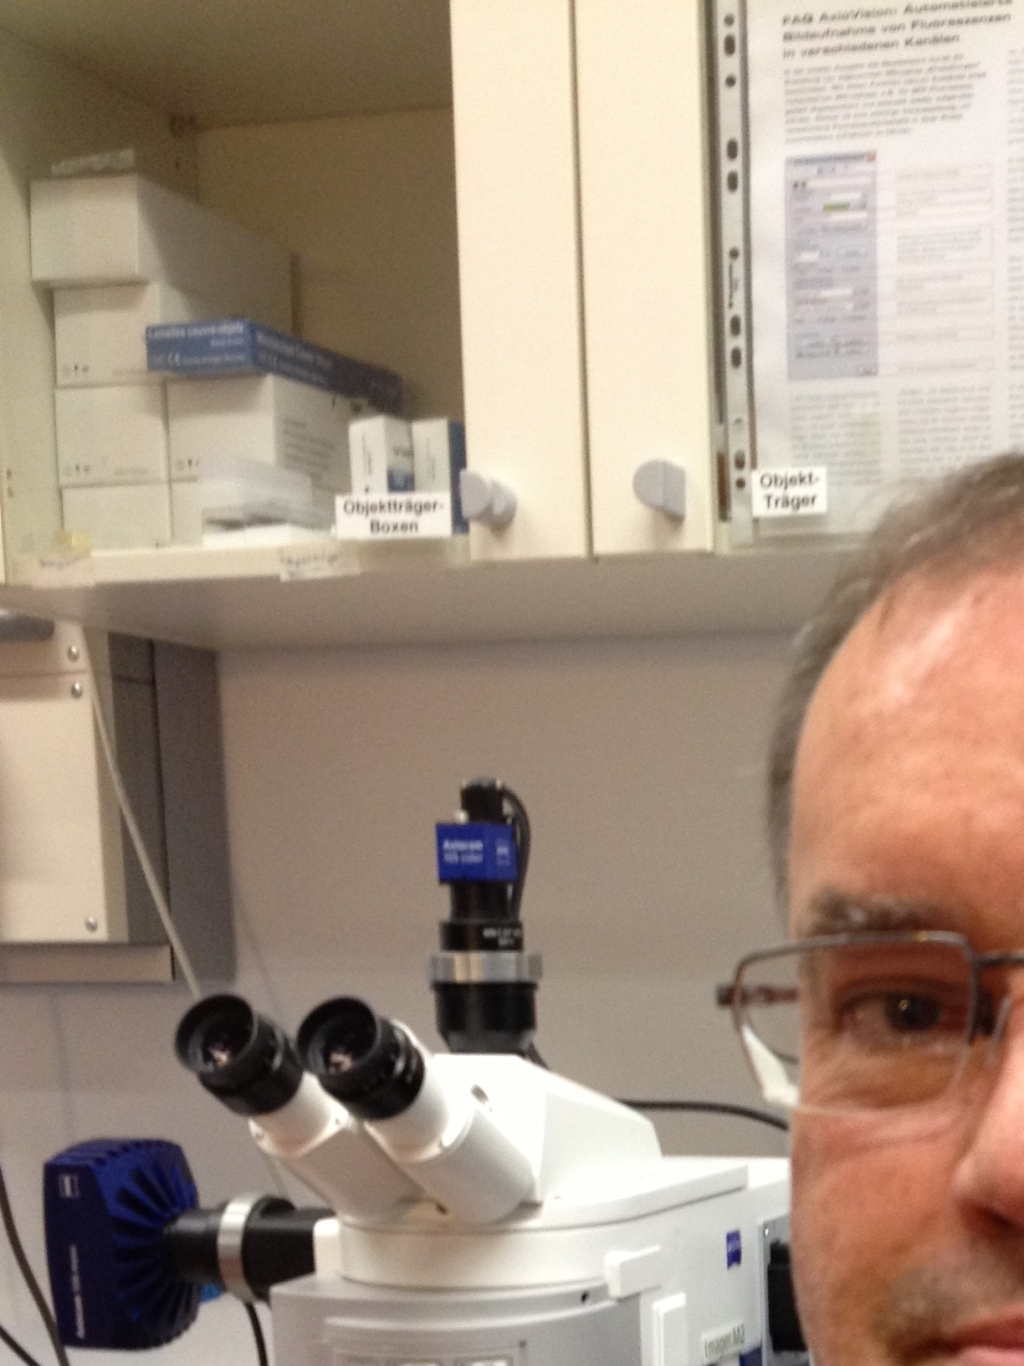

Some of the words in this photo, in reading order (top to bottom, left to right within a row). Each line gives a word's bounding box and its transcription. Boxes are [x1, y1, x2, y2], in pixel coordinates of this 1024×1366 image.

[782, 14, 813, 26] FAQ
[782, 26, 876, 42] Bildaufnahme
[881, 23, 905, 34] von
[911, 13, 1011, 30] Fluoreszenzen
[782, 49, 795, 59] in
[800, 40, 899, 57] verschiedenen
[904, 34, 960, 48] Kanälen
[760, 470, 819, 491] Objekt-
[343, 499, 443, 517] Objektträger-
[764, 493, 816, 511] Träger
[370, 520, 418, 533] Boxen
